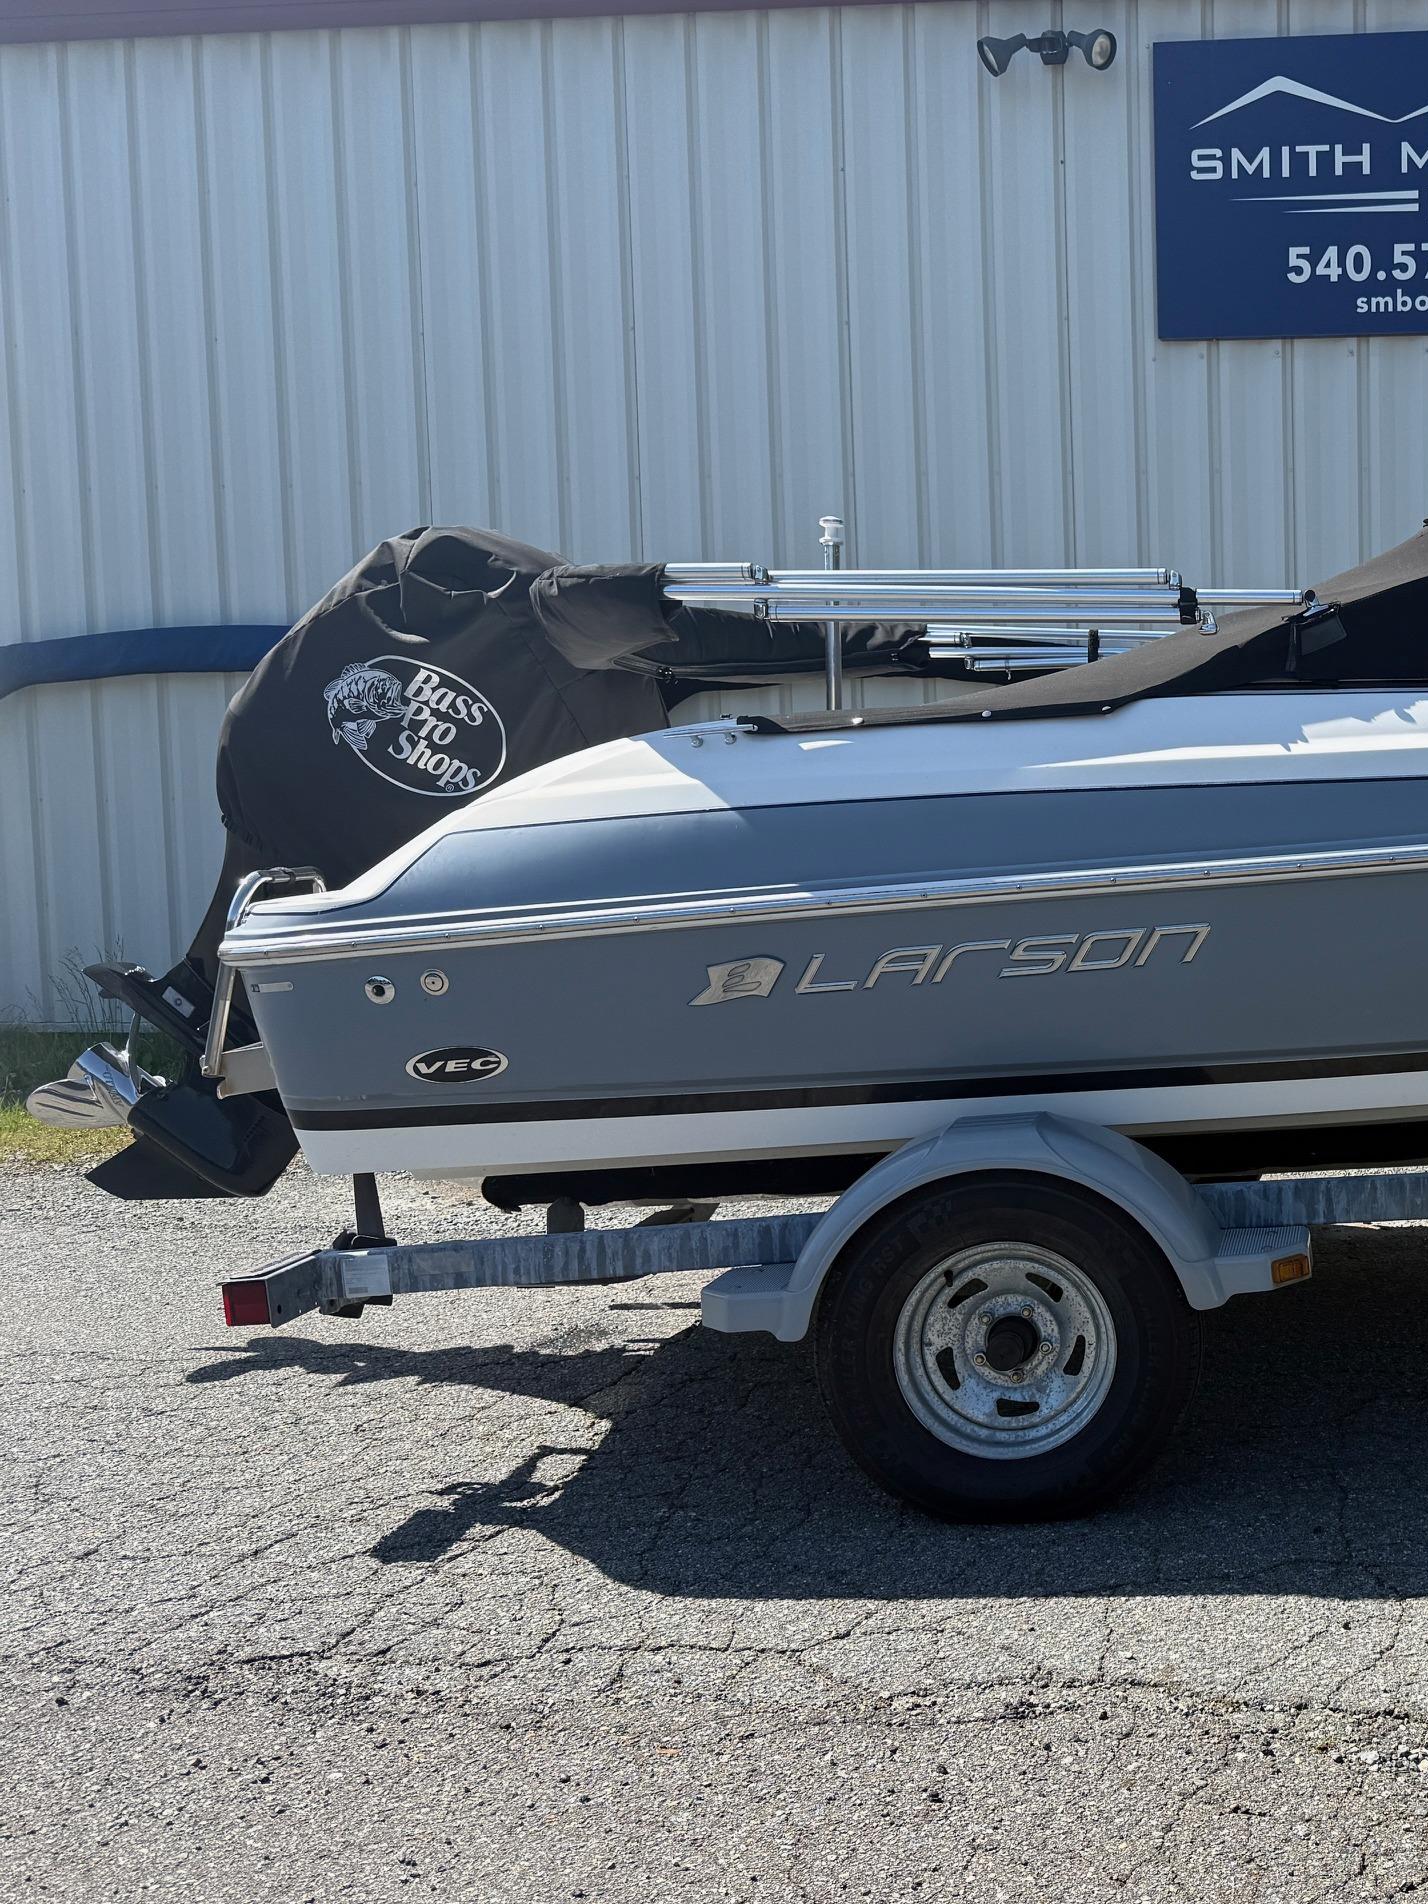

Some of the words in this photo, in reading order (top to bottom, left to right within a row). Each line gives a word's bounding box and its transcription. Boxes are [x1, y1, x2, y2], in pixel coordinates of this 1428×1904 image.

[1190, 142, 1371, 181] SMITH
[403, 668, 489, 726] Bass
[400, 700, 457, 745] Pro
[387, 730, 481, 791] Shops
[415, 1056, 500, 1075] VEC
